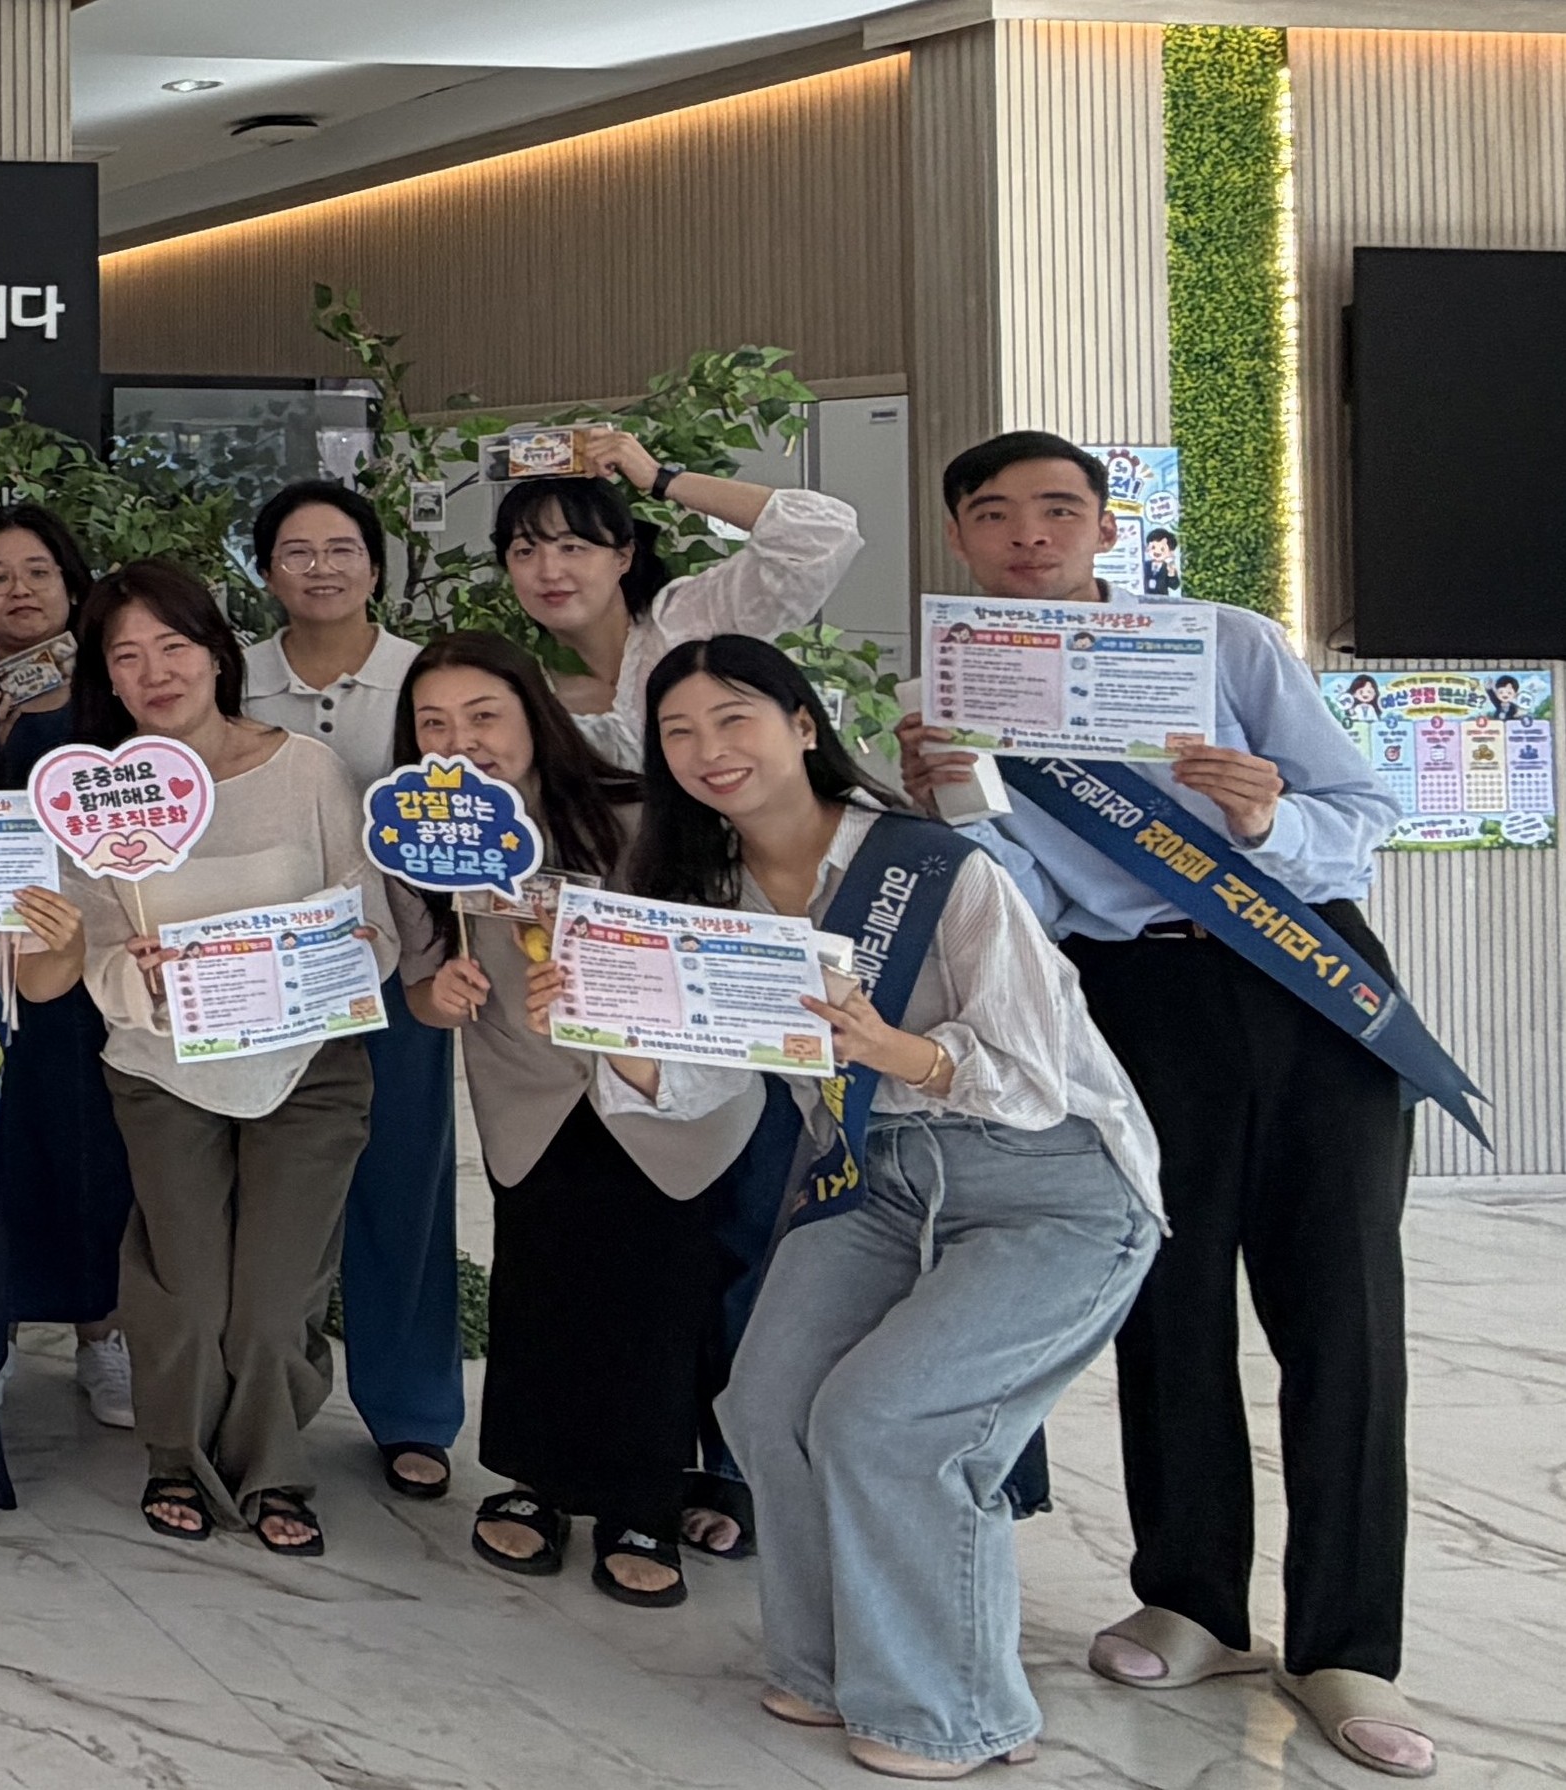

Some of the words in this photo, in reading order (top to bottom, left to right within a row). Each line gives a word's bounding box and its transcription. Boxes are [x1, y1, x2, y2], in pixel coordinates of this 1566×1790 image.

[72, 761, 157, 792] 존중해요
[78, 784, 166, 814] 함께해요
[394, 791, 451, 820] 갑질
[451, 794, 496, 822] 없는
[65, 812, 103, 836] 좋은
[106, 804, 188, 830] 조직문화
[416, 821, 483, 846] 공정한
[398, 842, 509, 881] 임실교육
[1133, 819, 1219, 884] 청렴
[1211, 872, 1351, 988] 서포터스
